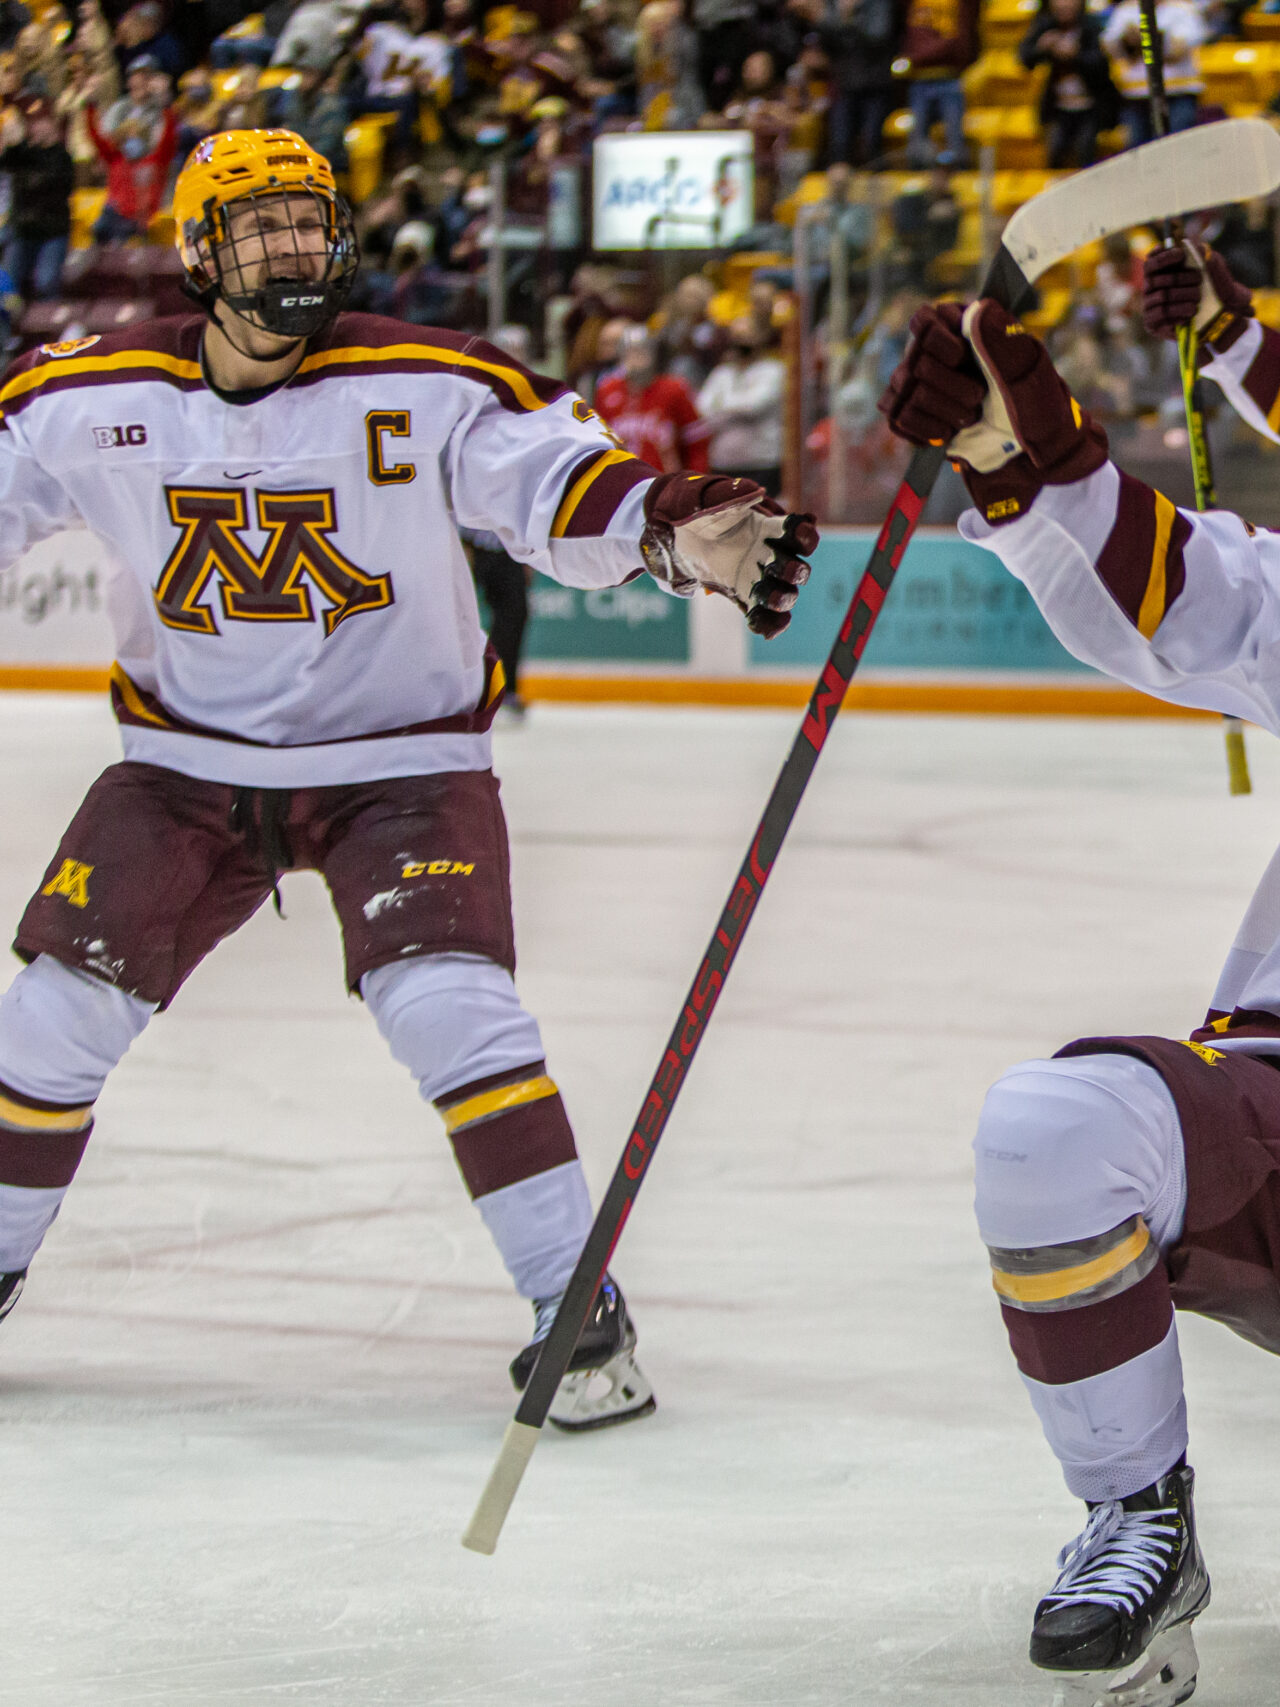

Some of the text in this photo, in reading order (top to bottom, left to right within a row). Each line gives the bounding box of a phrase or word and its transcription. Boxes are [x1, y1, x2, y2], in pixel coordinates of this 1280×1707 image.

[281, 295, 325, 308] CCM
[364, 409, 416, 486] C
[152, 485, 395, 639] M
[802, 481, 928, 753] CCM
[41, 857, 95, 909] M
[401, 860, 476, 879] CCM
[623, 821, 773, 1181] JETSPEED
